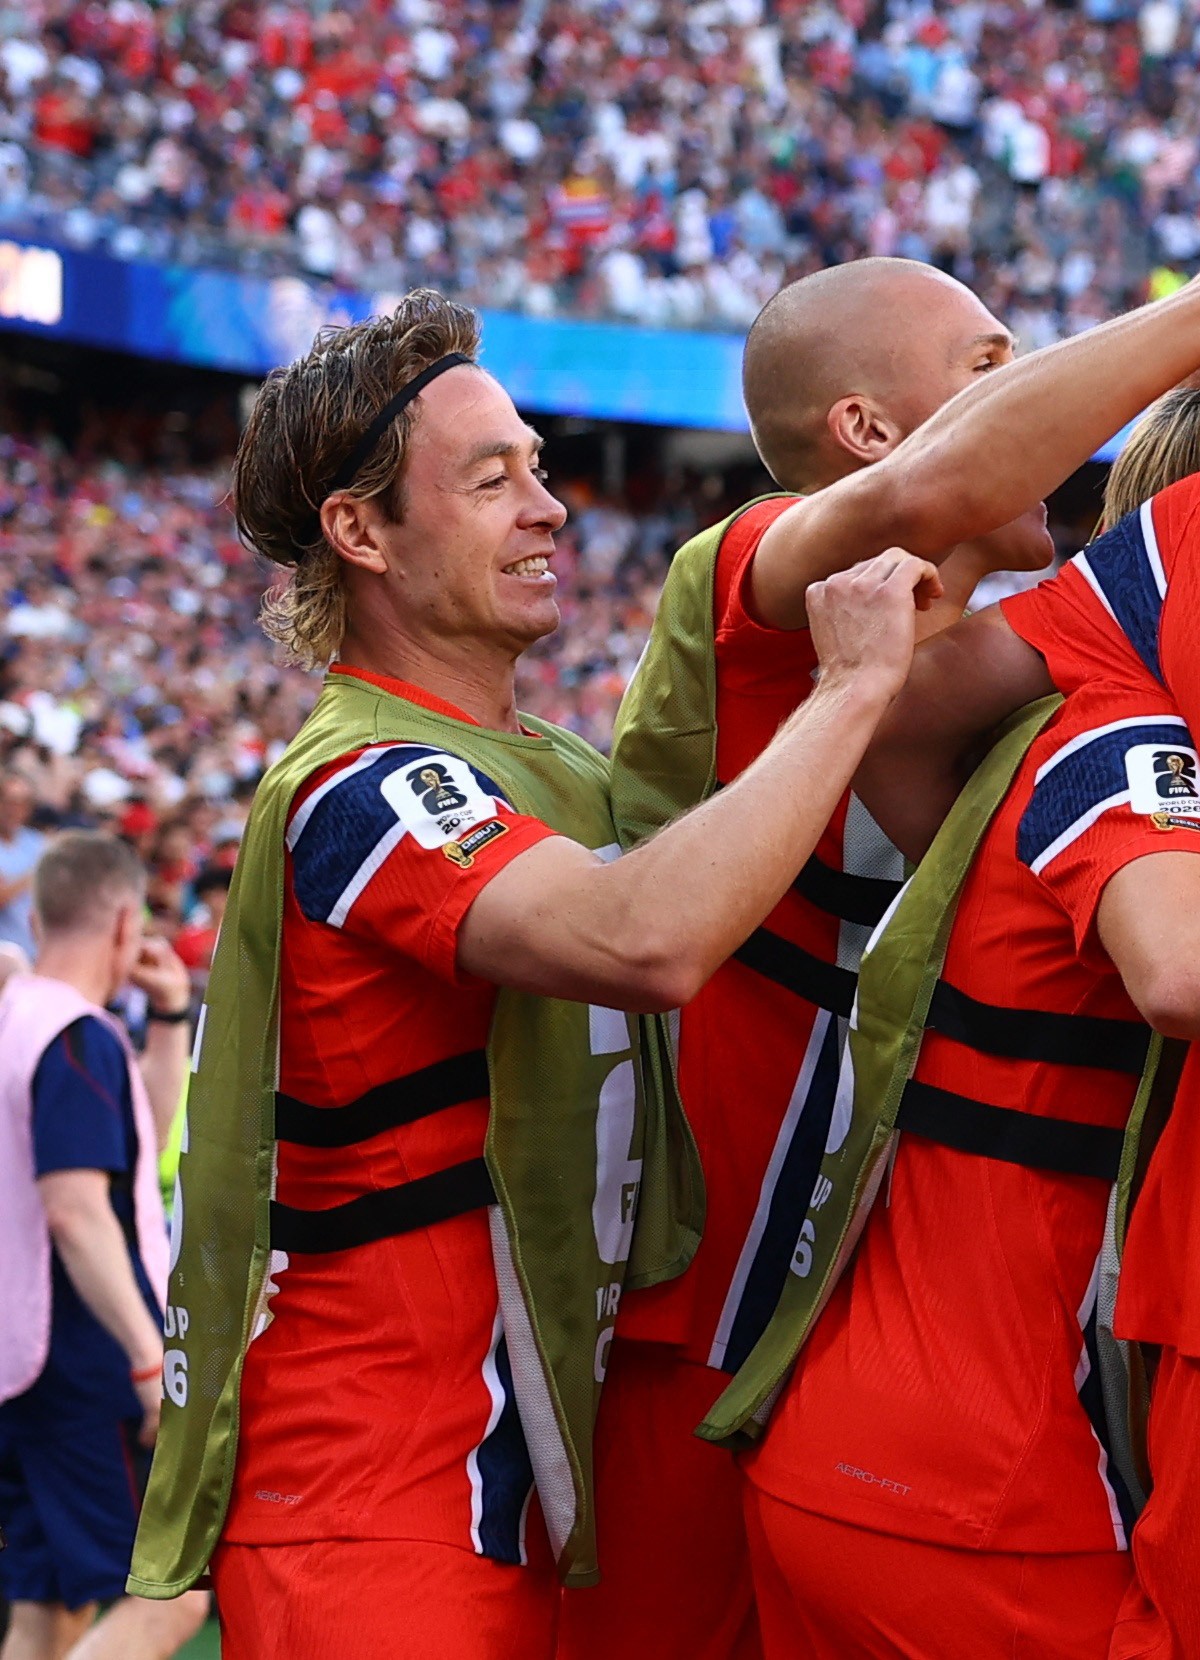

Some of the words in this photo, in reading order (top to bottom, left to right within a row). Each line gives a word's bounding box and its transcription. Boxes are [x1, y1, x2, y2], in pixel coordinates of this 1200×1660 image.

[1168, 786, 1191, 795] FIFA
[461, 822, 497, 850] DEBUT
[161, 1349, 189, 1408] 6
[834, 1462, 912, 1496] AERO-FIT
